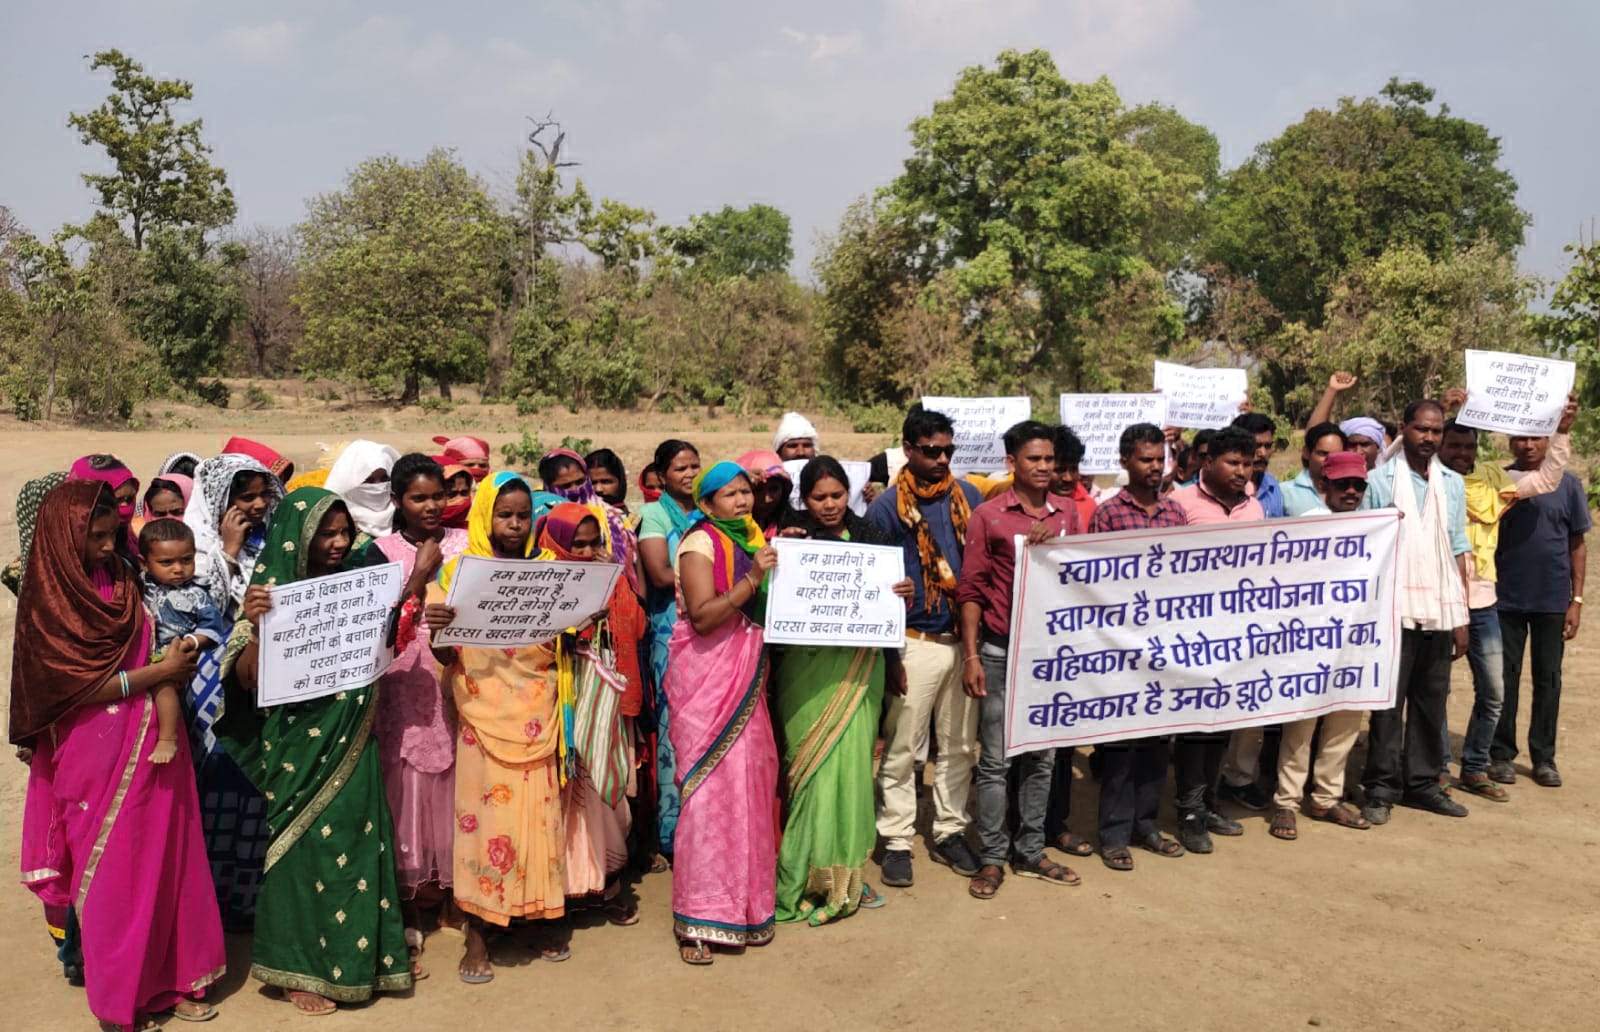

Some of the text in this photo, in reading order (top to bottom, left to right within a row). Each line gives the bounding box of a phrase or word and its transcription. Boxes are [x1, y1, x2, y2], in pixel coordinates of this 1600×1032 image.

[800, 552, 876, 567] हम ग्रामीणों ने
[1058, 530, 1372, 584] स्वागत है राजस्थान निगम का,
[490, 568, 586, 582] हम ग्रामीणों ने
[810, 570, 852, 584] पहचाना
[280, 572, 388, 606] गांव के विकास के लिए
[496, 585, 549, 597] पहचाना
[796, 584, 880, 600] बाहरी लोगों को
[324, 602, 338, 616] यह
[341, 596, 364, 610] ठाना
[478, 597, 579, 611] बाहरी लोगों को
[810, 604, 848, 617] भगाना
[1046, 603, 1128, 635] स्वागत
[1132, 590, 1150, 625] है
[1155, 593, 1214, 621] परसा
[1220, 576, 1325, 614] परियोजना
[272, 604, 386, 642] बाहरी लोगों के बहकावे
[490, 614, 535, 624] भगाना
[773, 620, 806, 633] परसा
[810, 622, 842, 634] खदान
[846, 623, 882, 634] बनाना
[444, 627, 482, 638] परसा
[484, 628, 526, 639] खदान
[283, 636, 325, 660] ग्रामीणों
[328, 632, 341, 649] को
[346, 626, 378, 644] बचाना
[1032, 616, 1381, 682] बहिष्कार है पेशेवर विरोधियों का,
[310, 646, 372, 670] परसा खदान
[294, 674, 310, 690] को
[340, 662, 372, 679] कराना
[1028, 692, 1140, 728] बहिष्कार
[1144, 680, 1164, 714] है
[1168, 678, 1232, 712] उनके
[1236, 670, 1273, 712] झूठे
[1278, 662, 1330, 700] दावों
